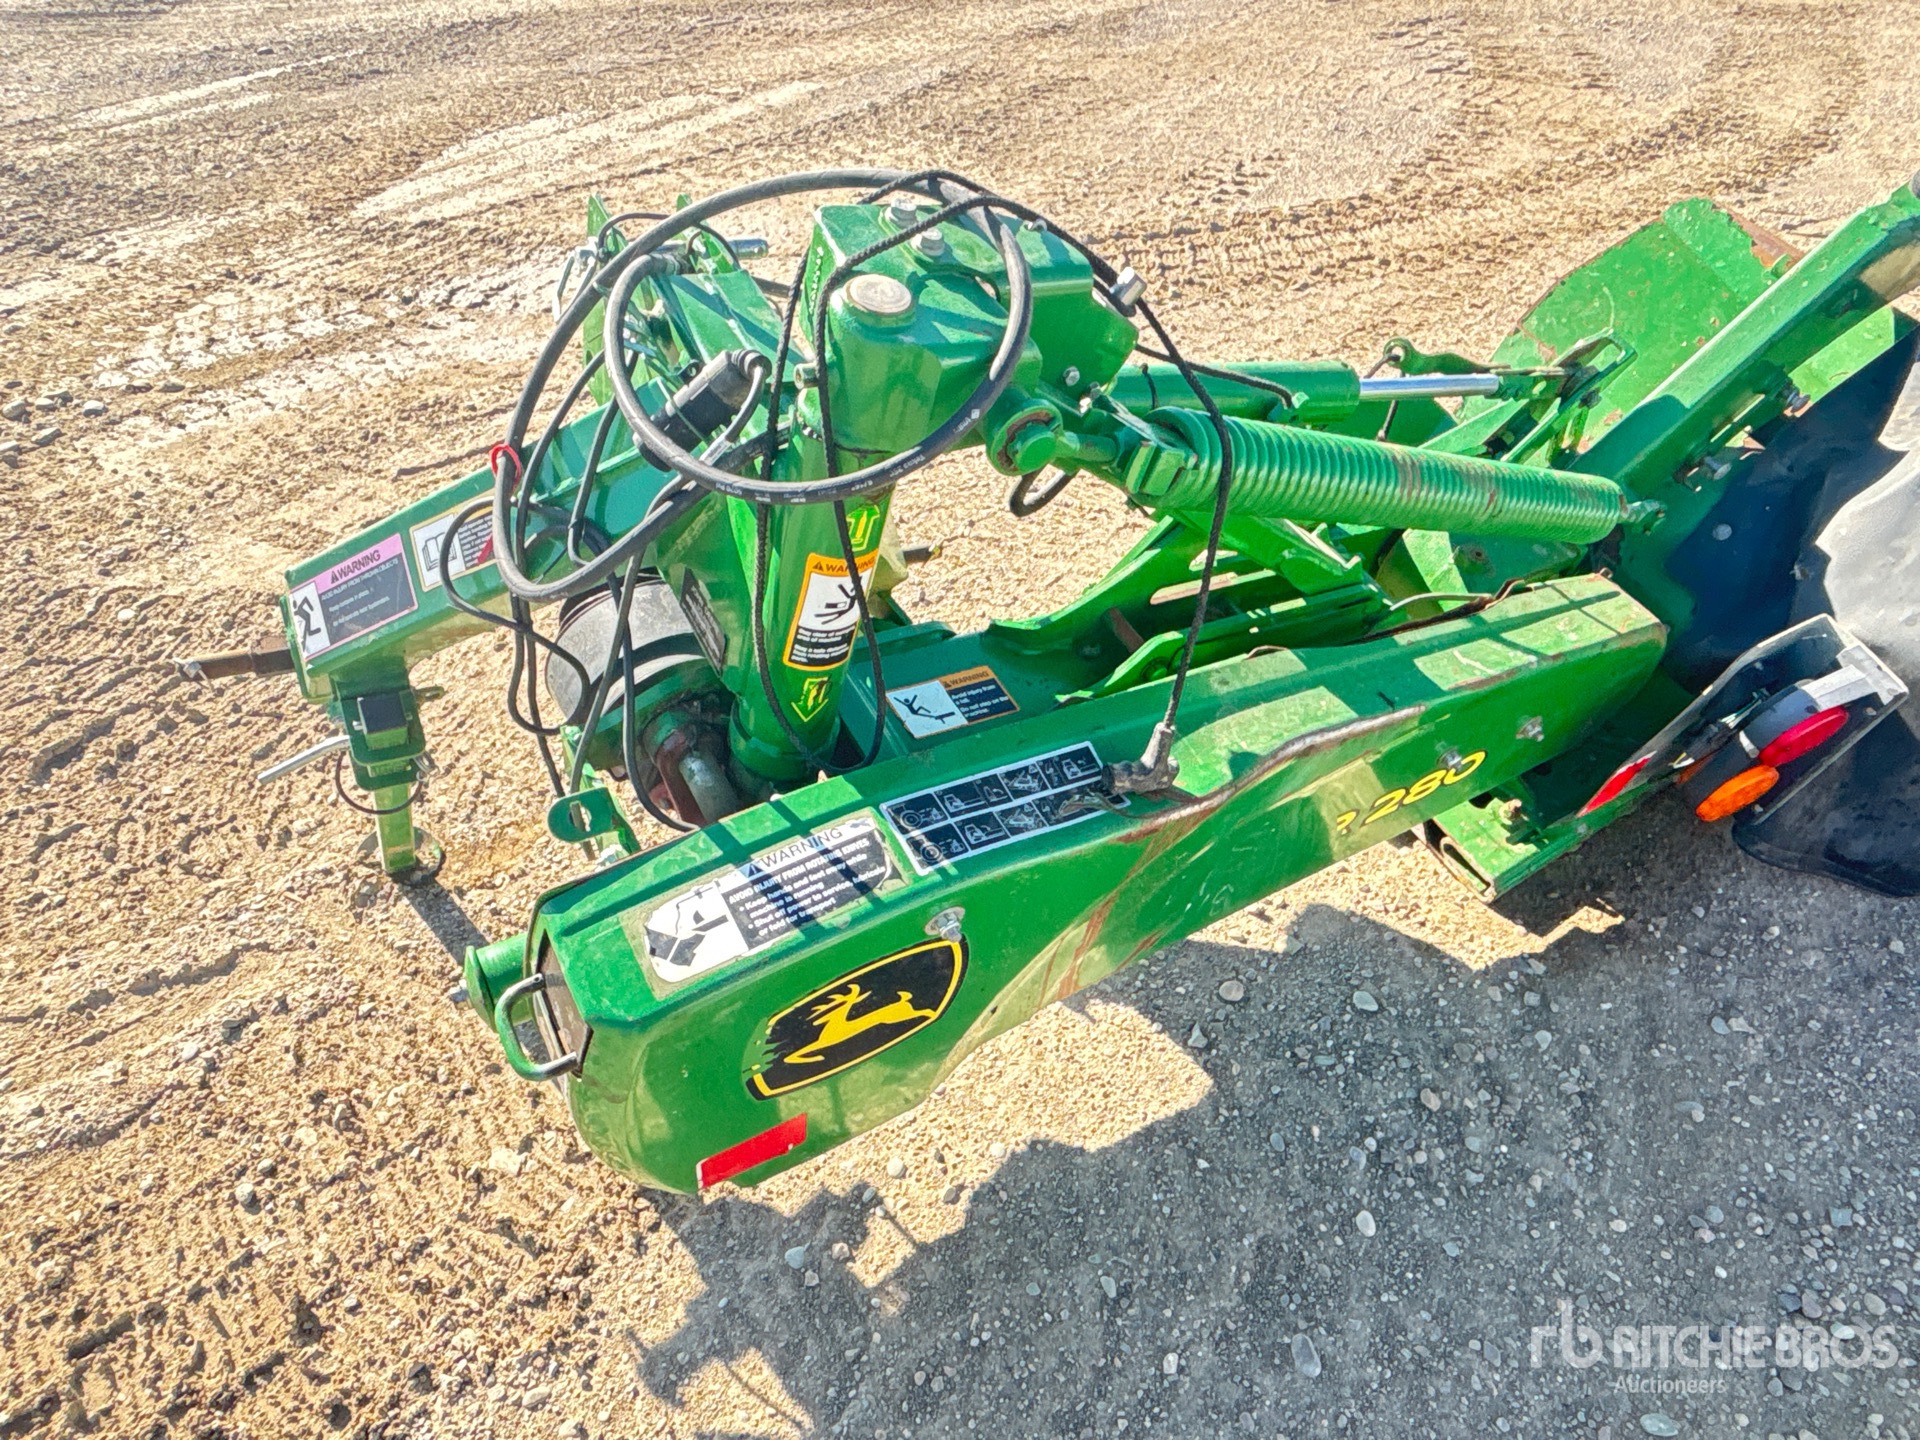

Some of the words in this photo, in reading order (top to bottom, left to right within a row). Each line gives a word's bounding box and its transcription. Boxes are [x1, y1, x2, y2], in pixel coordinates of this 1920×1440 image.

[337, 549, 381, 579] WARNING
[825, 556, 876, 573] WAING
[950, 671, 989, 686] WARNING
[760, 827, 843, 868] WARNING
[729, 887, 754, 904] AVOID
[753, 874, 782, 893] INJURY
[782, 864, 806, 880] FROM
[805, 849, 843, 870] ROTATING
[841, 837, 870, 855] KNIVES
[745, 896, 768, 910] Keep
[767, 884, 793, 900] hands
[793, 876, 809, 889] and
[808, 869, 826, 881] feet
[825, 862, 846, 875] away
[846, 853, 868, 866] while
[750, 899, 785, 919] machine
[784, 895, 794, 903] is
[793, 881, 825, 900] running
[754, 913, 774, 928] Shut
[774, 907, 786, 919] off
[786, 897, 812, 914] power
[812, 892, 823, 902] to
[822, 880, 854, 897] service,
[758, 927, 769, 937] or
[768, 918, 786, 932] fold
[785, 914, 798, 924] for
[798, 897, 837, 918] transport
